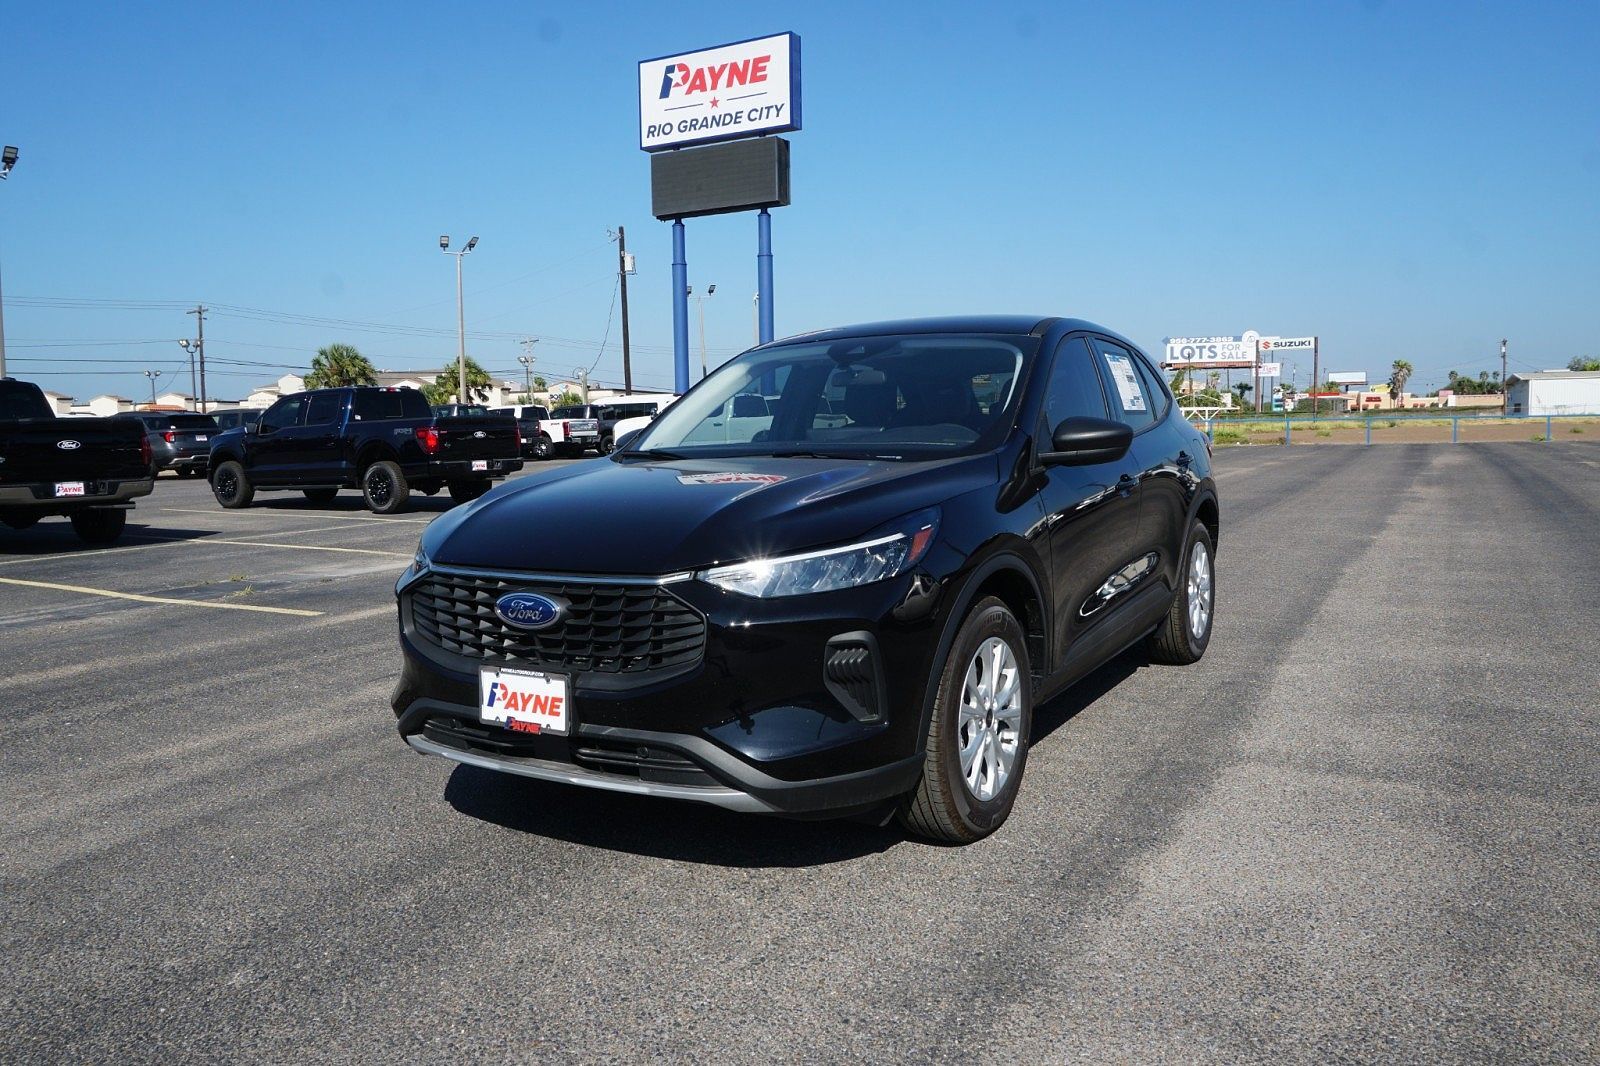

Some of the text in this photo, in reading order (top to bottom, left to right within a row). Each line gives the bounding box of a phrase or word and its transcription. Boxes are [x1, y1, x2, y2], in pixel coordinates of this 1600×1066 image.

[659, 55, 771, 99] PAYNE
[646, 103, 785, 138] RIO GRANDE CITY
[1170, 345, 1218, 360] LOTS
[1221, 343, 1241, 351] FOR
[1273, 340, 1311, 348] SUZUKI
[1221, 351, 1248, 360] SALE
[507, 599, 543, 621] Ford
[487, 682, 564, 717] PAYNE
[504, 716, 541, 735] PAYNE
